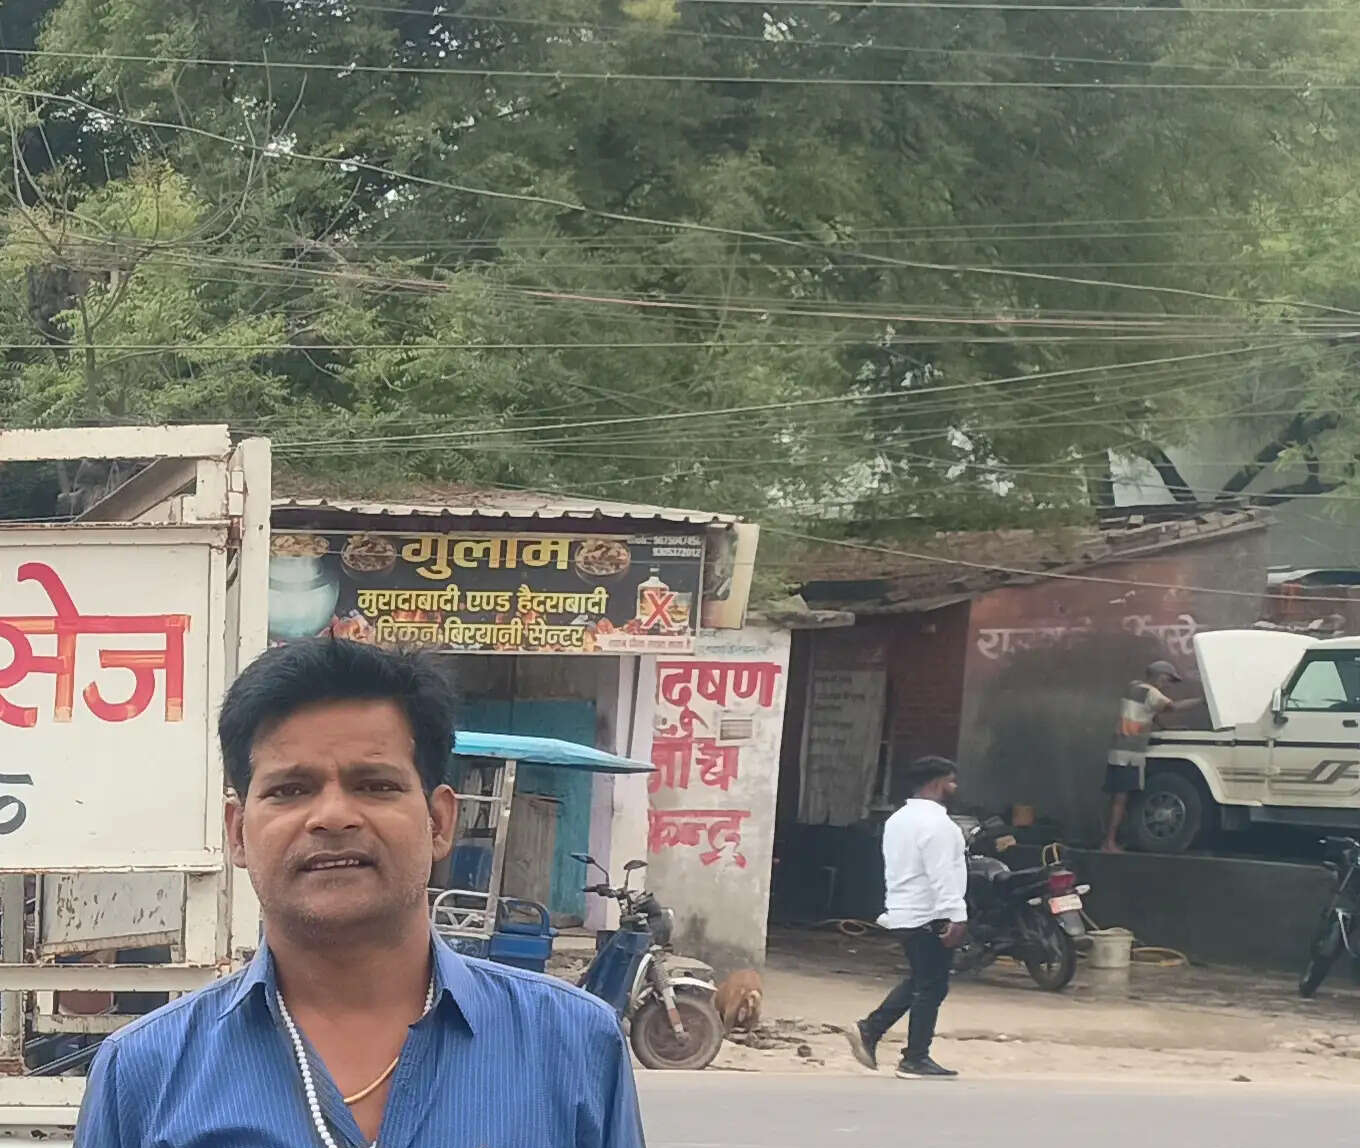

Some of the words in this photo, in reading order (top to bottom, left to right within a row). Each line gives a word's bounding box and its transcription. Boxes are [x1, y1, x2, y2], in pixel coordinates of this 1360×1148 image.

[400, 535, 576, 580] गुलाम
[357, 584, 460, 616] मुरादाबादी
[466, 591, 513, 611] एण्ड
[516, 584, 608, 614] हैदराबादी
[376, 615, 440, 643] चिकन
[443, 617, 523, 645] बिरयानी
[528, 617, 585, 646] सेन्टर
